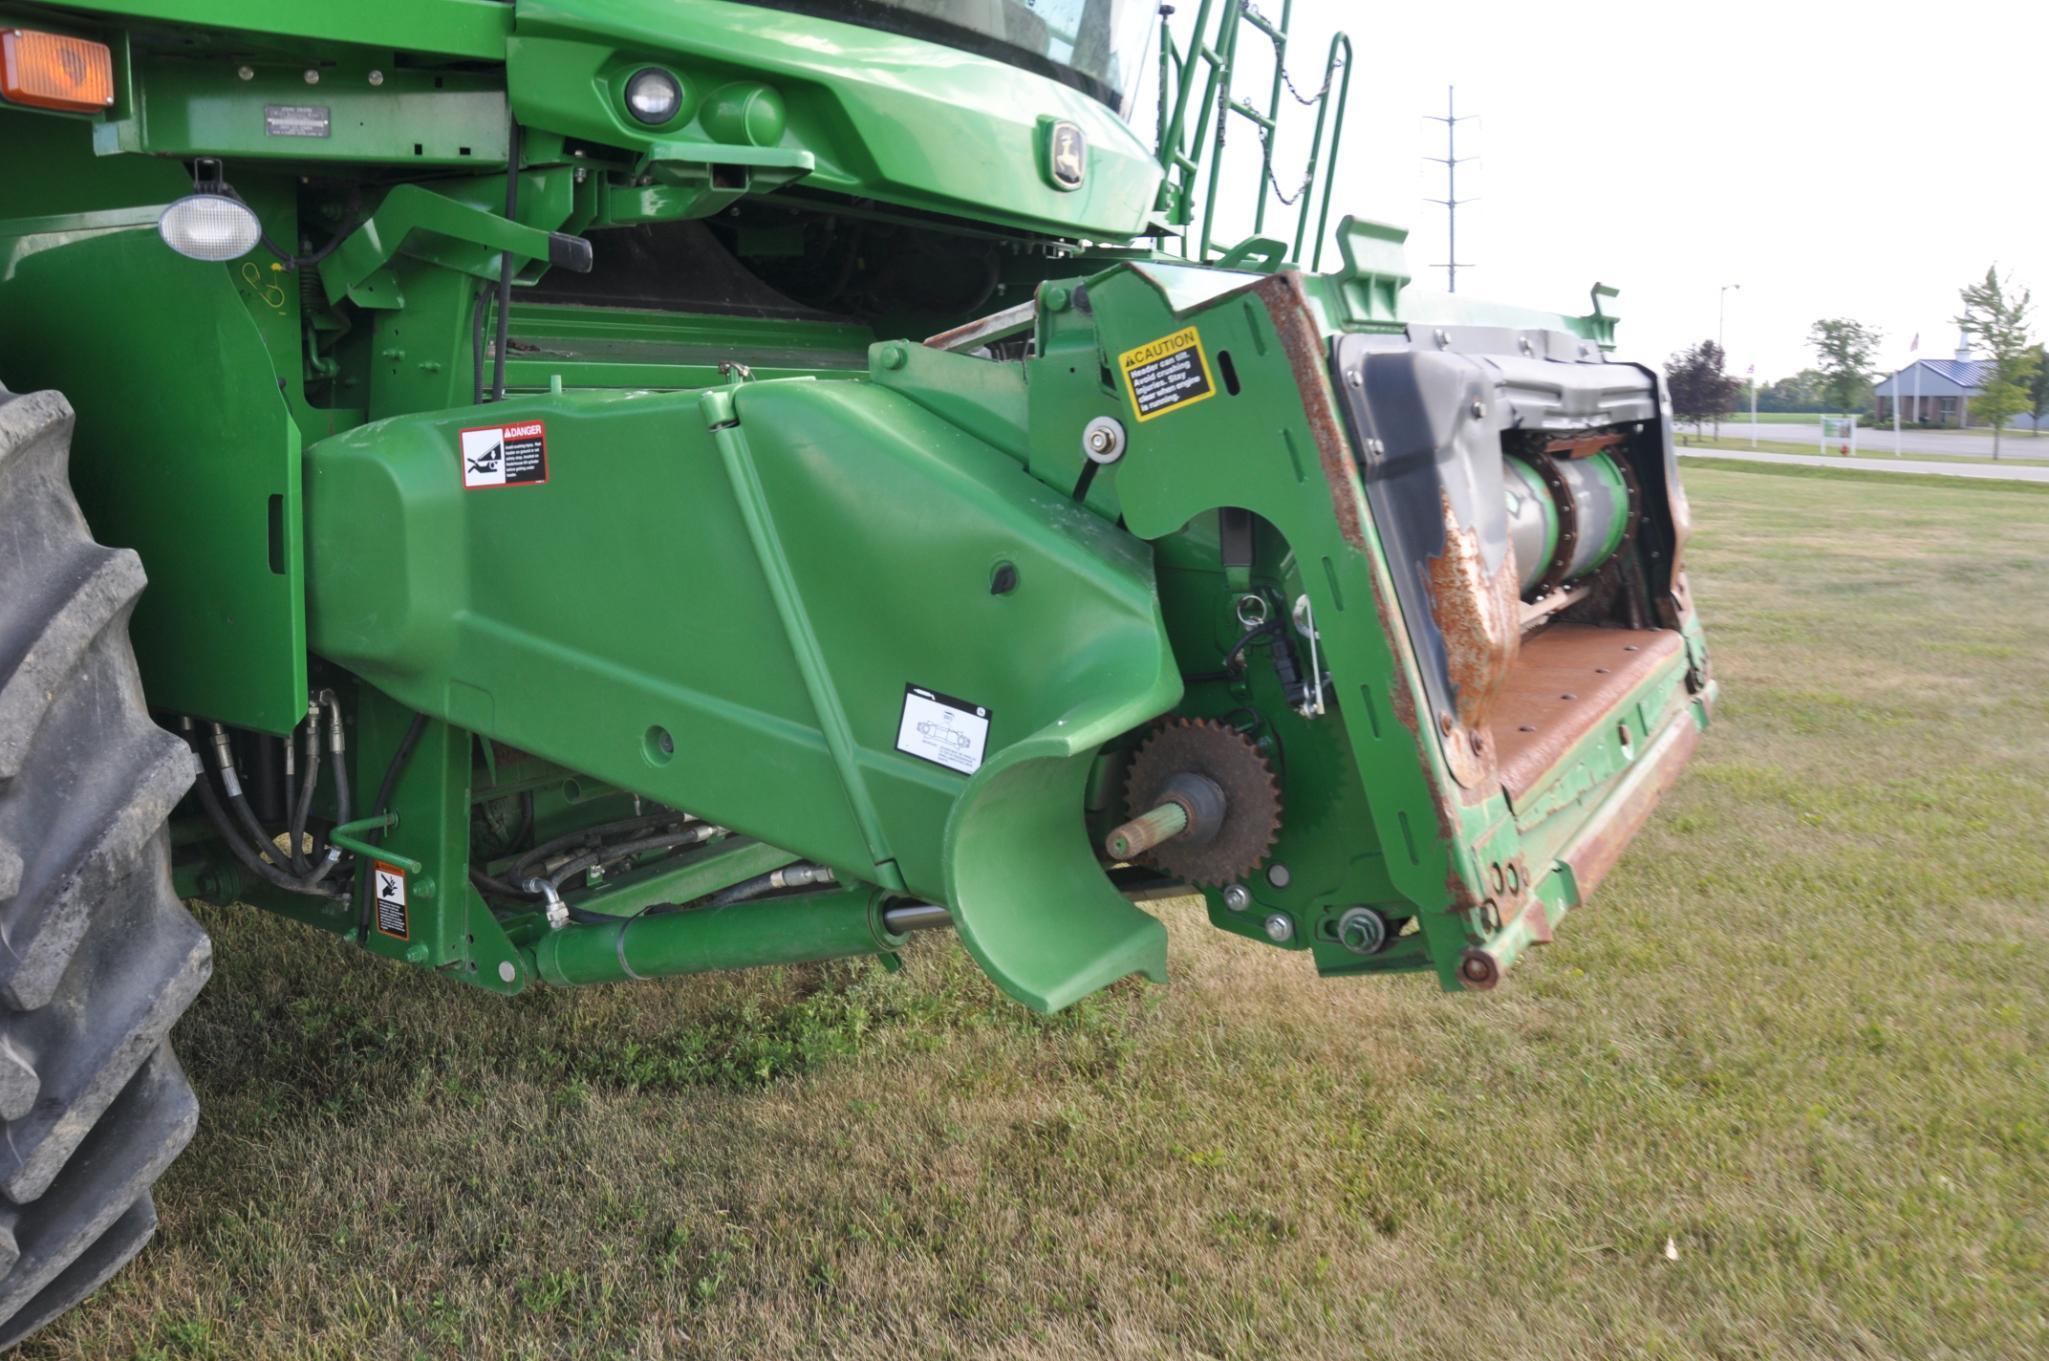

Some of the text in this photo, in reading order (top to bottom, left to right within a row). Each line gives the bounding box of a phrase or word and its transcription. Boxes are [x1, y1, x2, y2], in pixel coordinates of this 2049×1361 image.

[1134, 331, 1194, 363] CAUTION
[1130, 363, 1158, 379] Header
[1159, 357, 1175, 368] can
[1134, 361, 1191, 387] Avoid crushing
[1167, 372, 1186, 383] Stay
[1156, 385, 1176, 397] when
[1176, 376, 1201, 388] engine
[511, 425, 542, 437] DANGER
